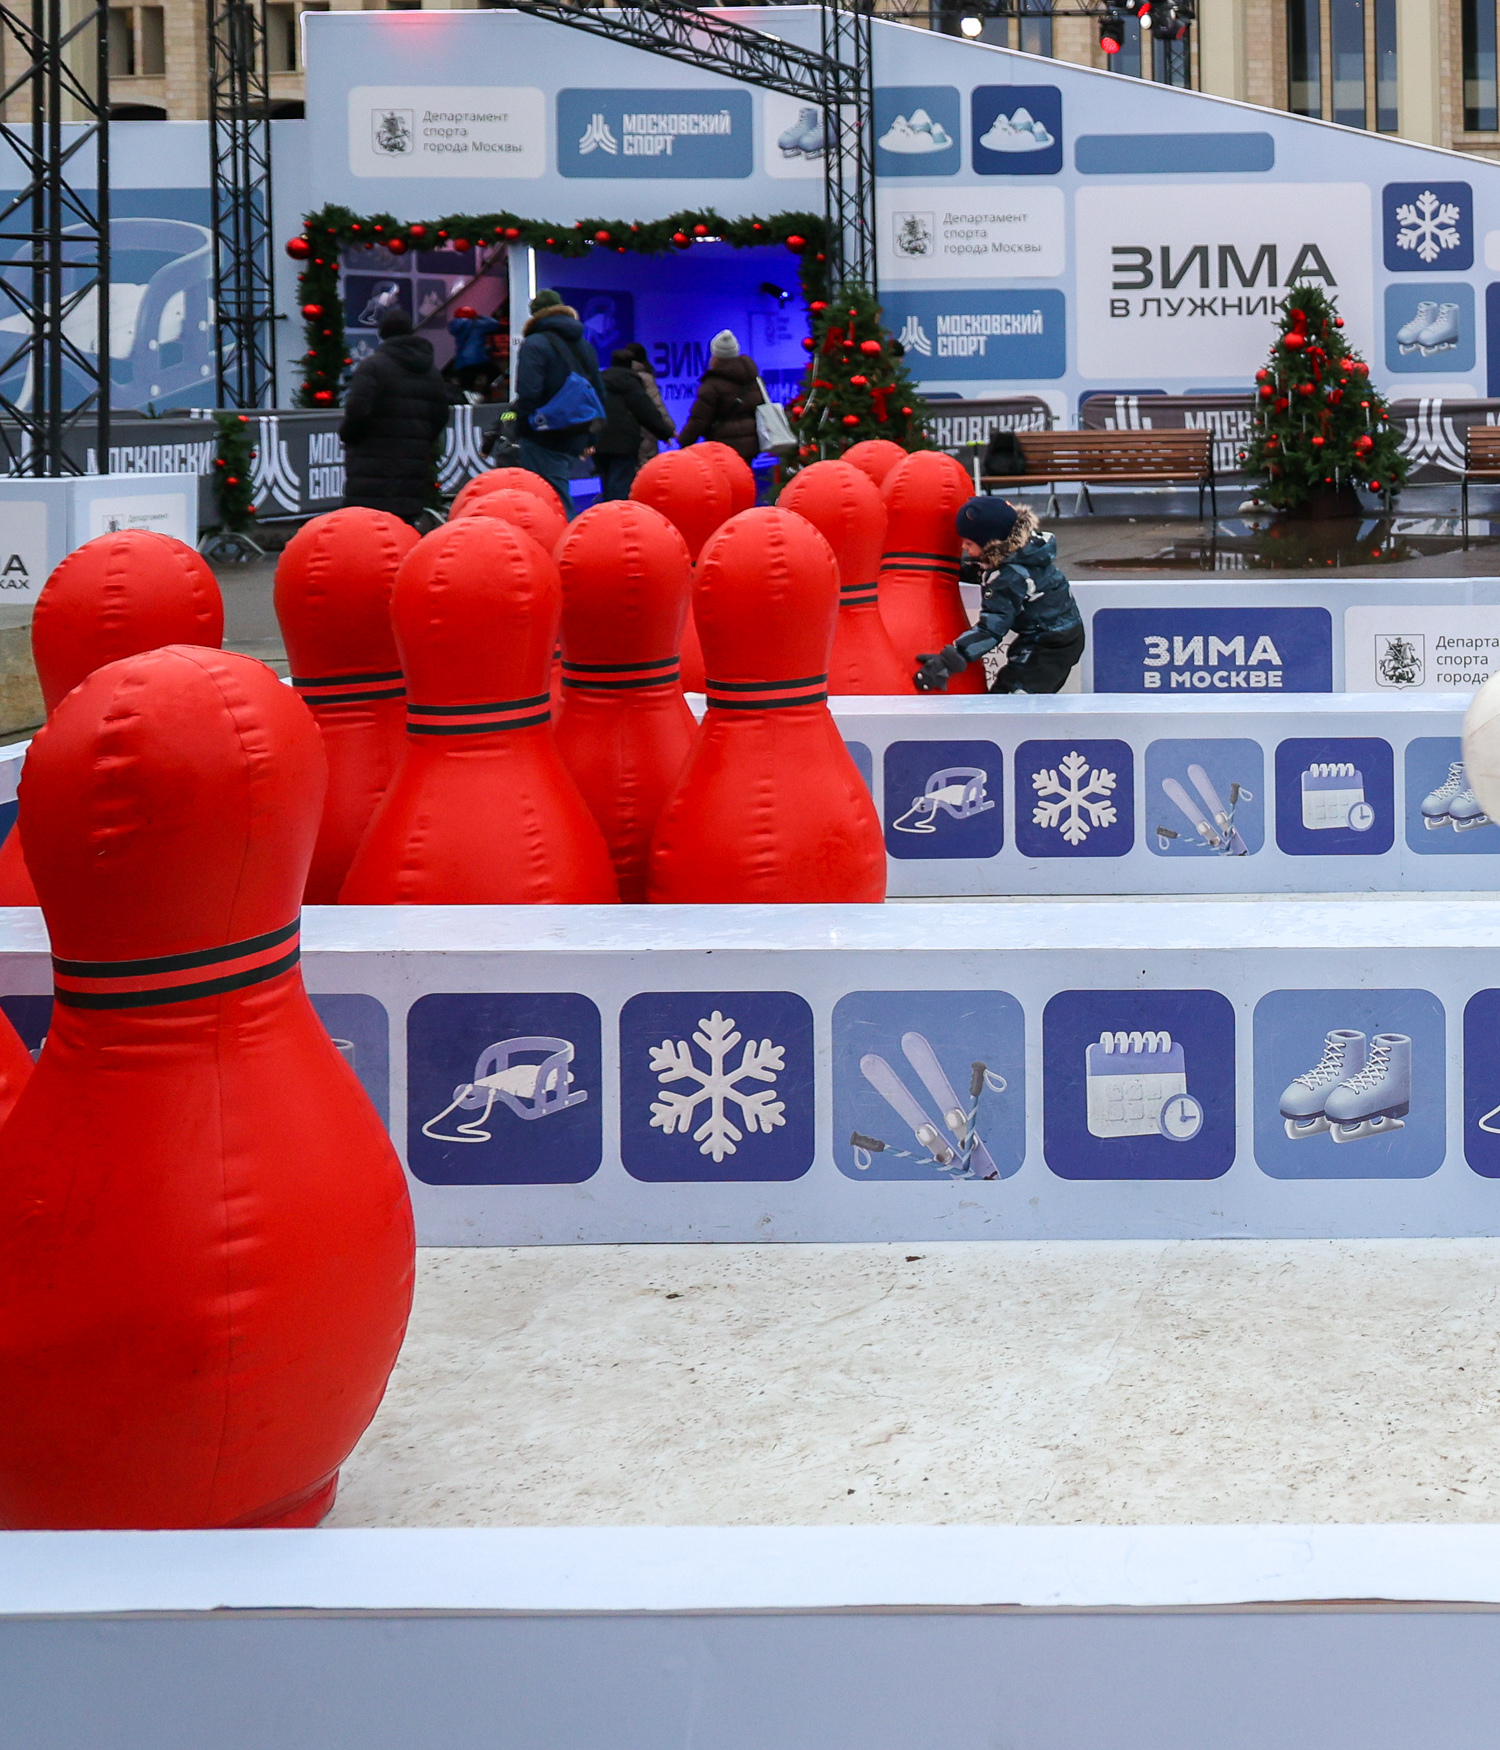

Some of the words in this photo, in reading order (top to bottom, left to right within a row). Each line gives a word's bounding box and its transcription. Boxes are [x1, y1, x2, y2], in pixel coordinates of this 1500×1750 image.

[423, 111, 508, 123] Департамент
[623, 110, 731, 135] МОСКОВСКИЙ
[423, 127, 467, 139] спорта
[424, 143, 467, 153] города
[472, 142, 522, 152] Москвы
[623, 135, 675, 155] СПОРТ
[943, 213, 1028, 225] Департамент
[944, 229, 987, 240] спорта
[944, 245, 987, 256] города
[991, 243, 1042, 253] Москвы
[1111, 244, 1338, 290] ЗИМА
[1110, 298, 1130, 317] В
[1139, 294, 1340, 317] ЛУЖНИК
[937, 310, 1043, 335] МОСКОВСКИЙ
[937, 336, 988, 357] СПОРТ
[654, 342, 711, 378] ЗИМ
[922, 407, 1046, 446] КОВСКИЙ
[309, 466, 348, 500] СПО
[1143, 635, 1283, 667] ЗИМА
[1436, 655, 1489, 668] спорта
[1144, 671, 1162, 688] В
[1170, 670, 1283, 688] МОСКВЕ
[1437, 672, 1489, 686] города
